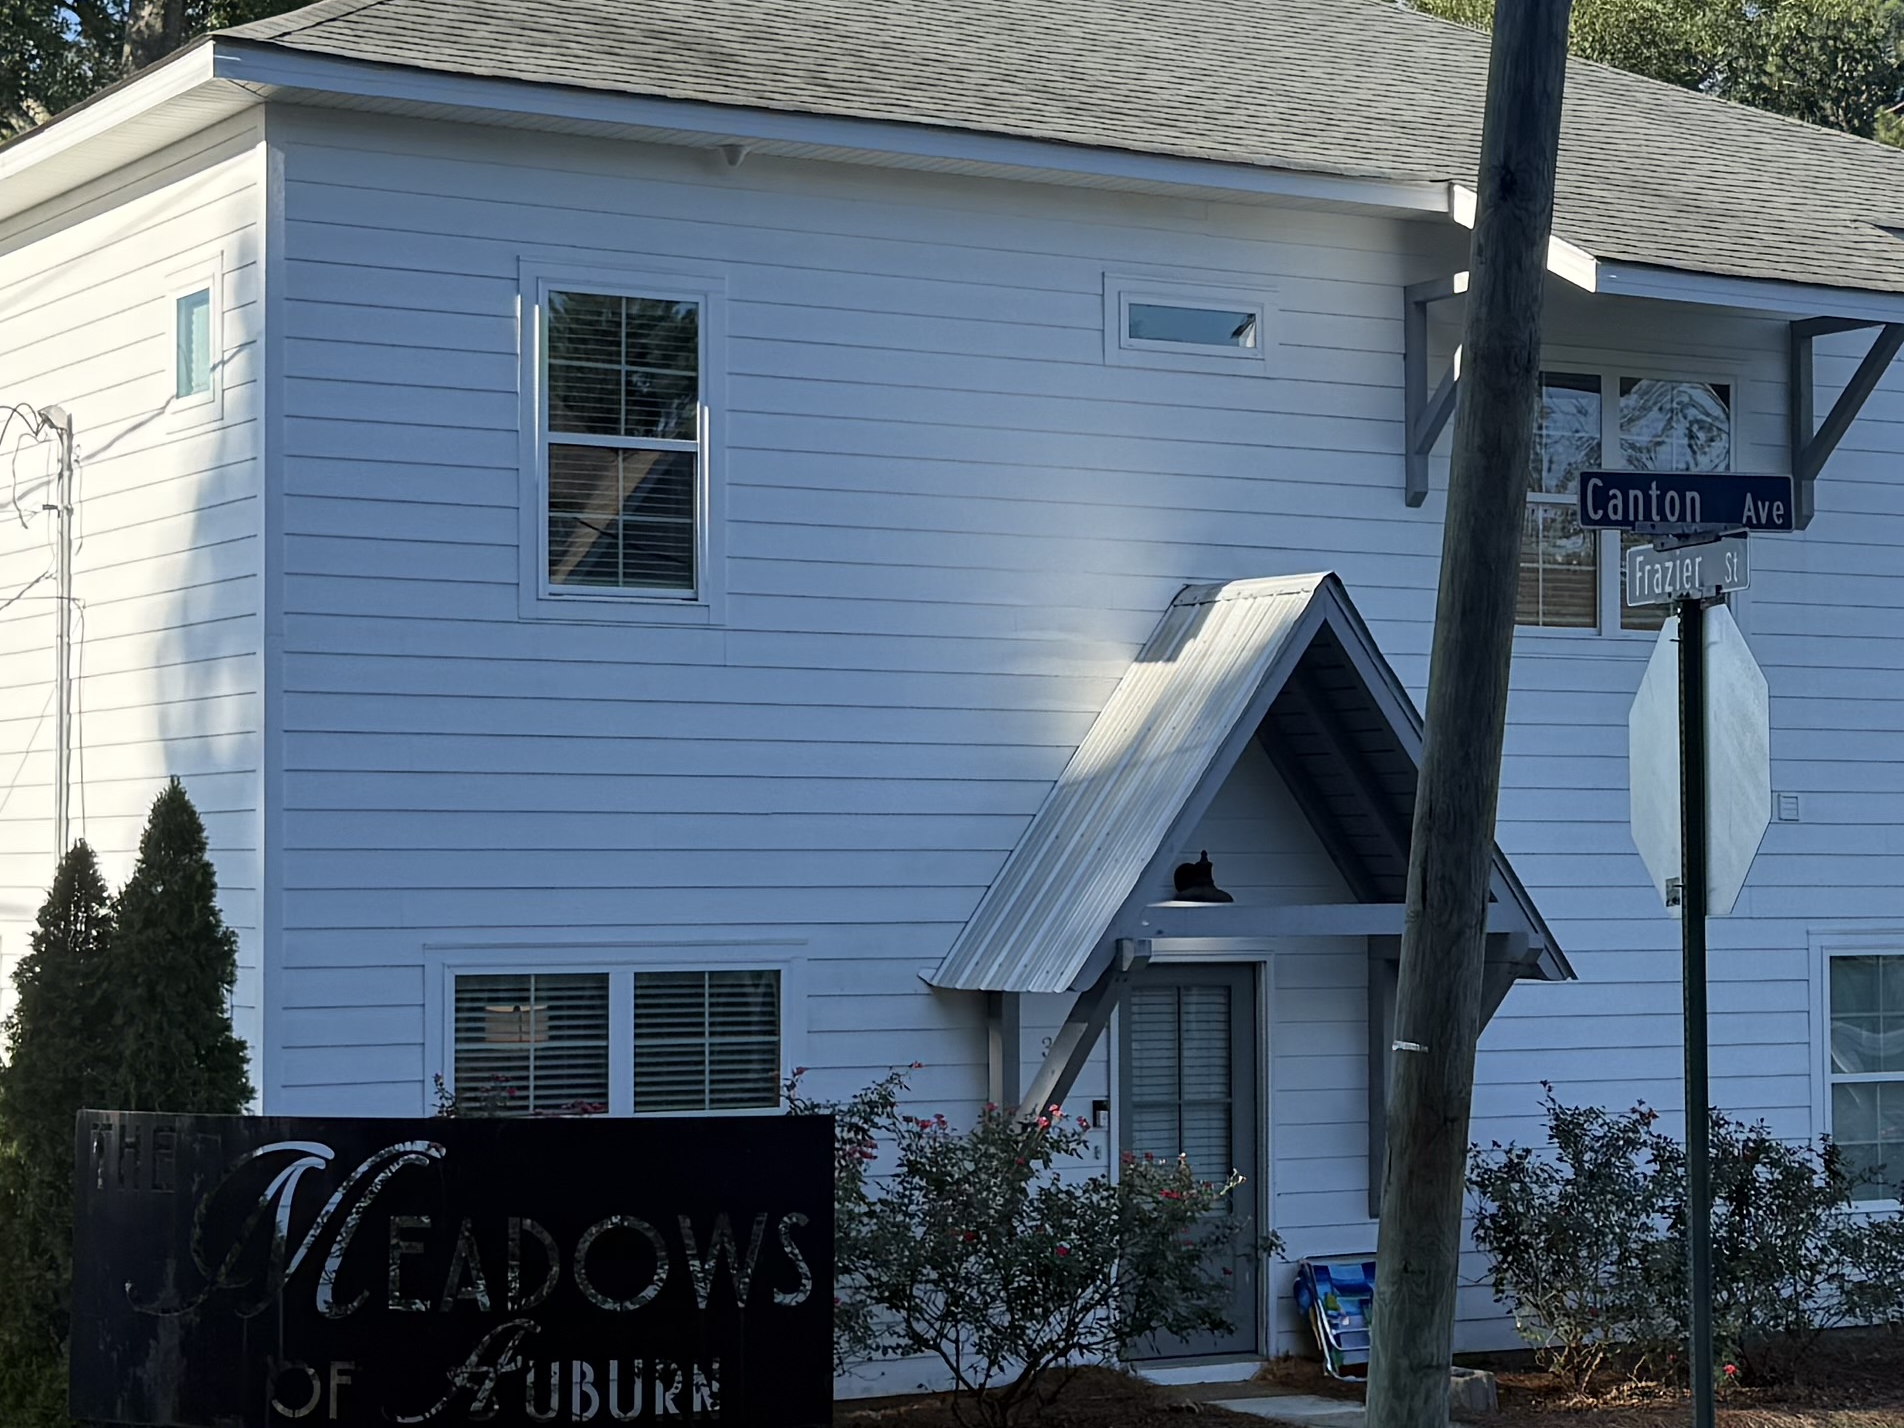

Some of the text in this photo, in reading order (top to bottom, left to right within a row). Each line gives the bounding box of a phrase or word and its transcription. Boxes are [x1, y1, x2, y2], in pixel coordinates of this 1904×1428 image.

[1586, 477, 1784, 525] Canton Ave
[1635, 550, 1739, 597] Frazier St
[269, 1317, 723, 1424] OF AUBURN
